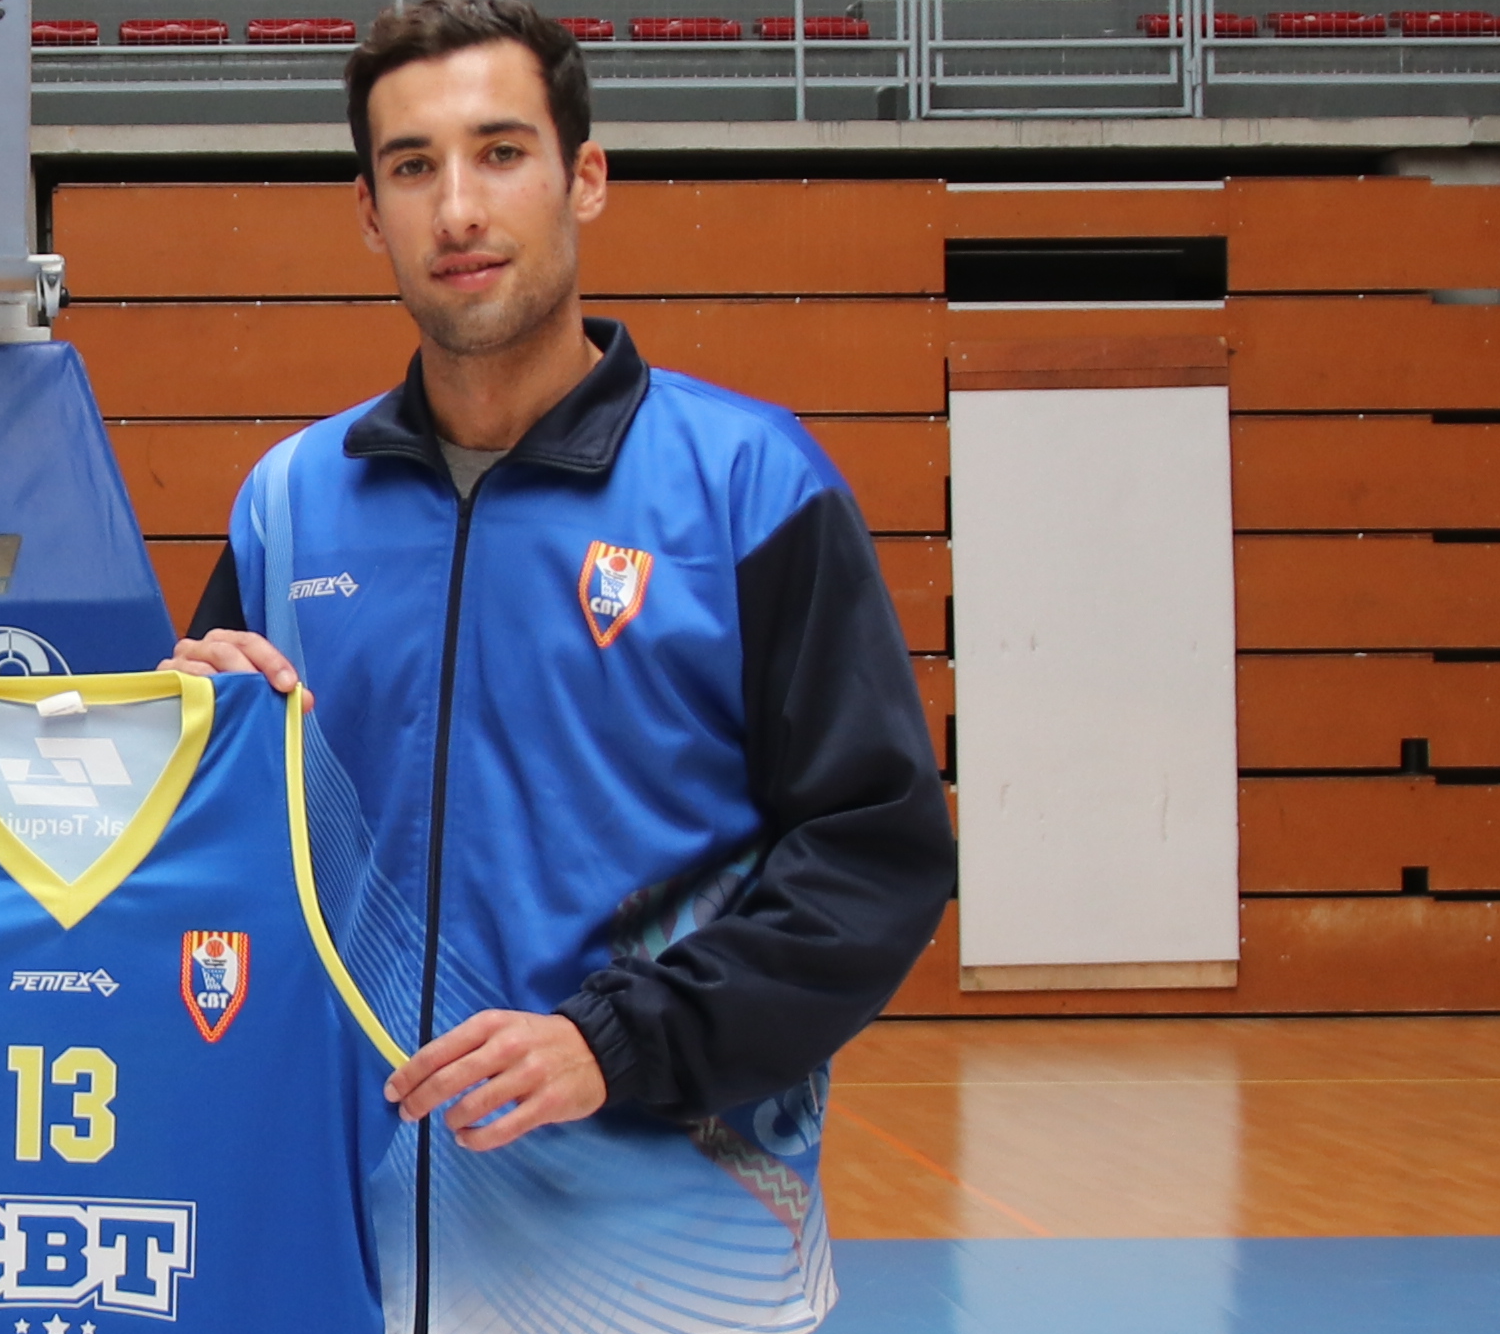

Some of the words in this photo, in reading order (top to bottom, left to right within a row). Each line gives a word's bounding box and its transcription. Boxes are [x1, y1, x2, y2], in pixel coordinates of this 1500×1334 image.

[288, 576, 338, 601] PENTEX
[590, 597, 622, 618] CBT
[9, 971, 94, 993] PENTEX
[197, 992, 230, 1009] CBT
[7, 1045, 118, 1164] 13
